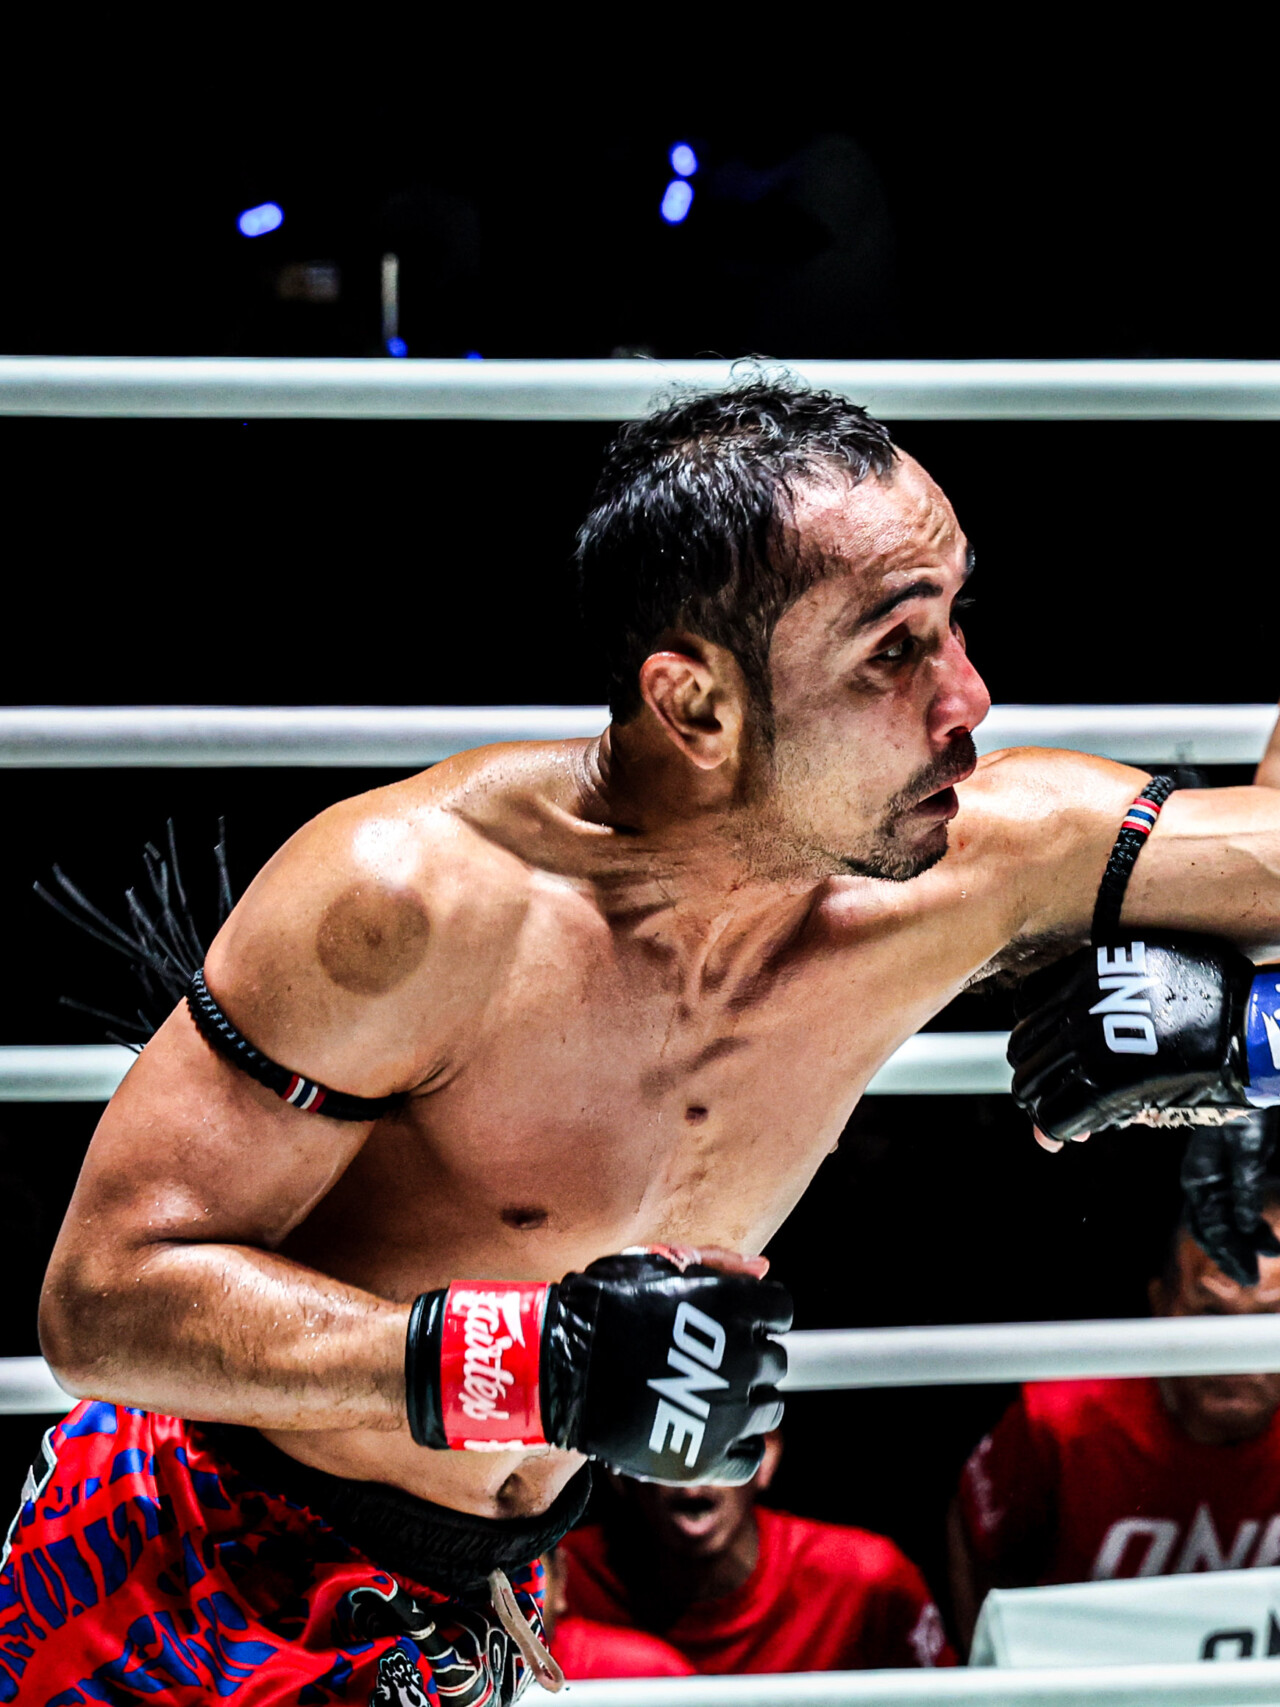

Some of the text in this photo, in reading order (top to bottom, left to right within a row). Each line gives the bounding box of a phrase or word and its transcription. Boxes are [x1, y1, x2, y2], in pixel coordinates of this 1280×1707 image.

[1088, 941, 1161, 1056] ONE
[452, 1289, 526, 1421] Fairtex
[647, 1301, 730, 1468] ONE
